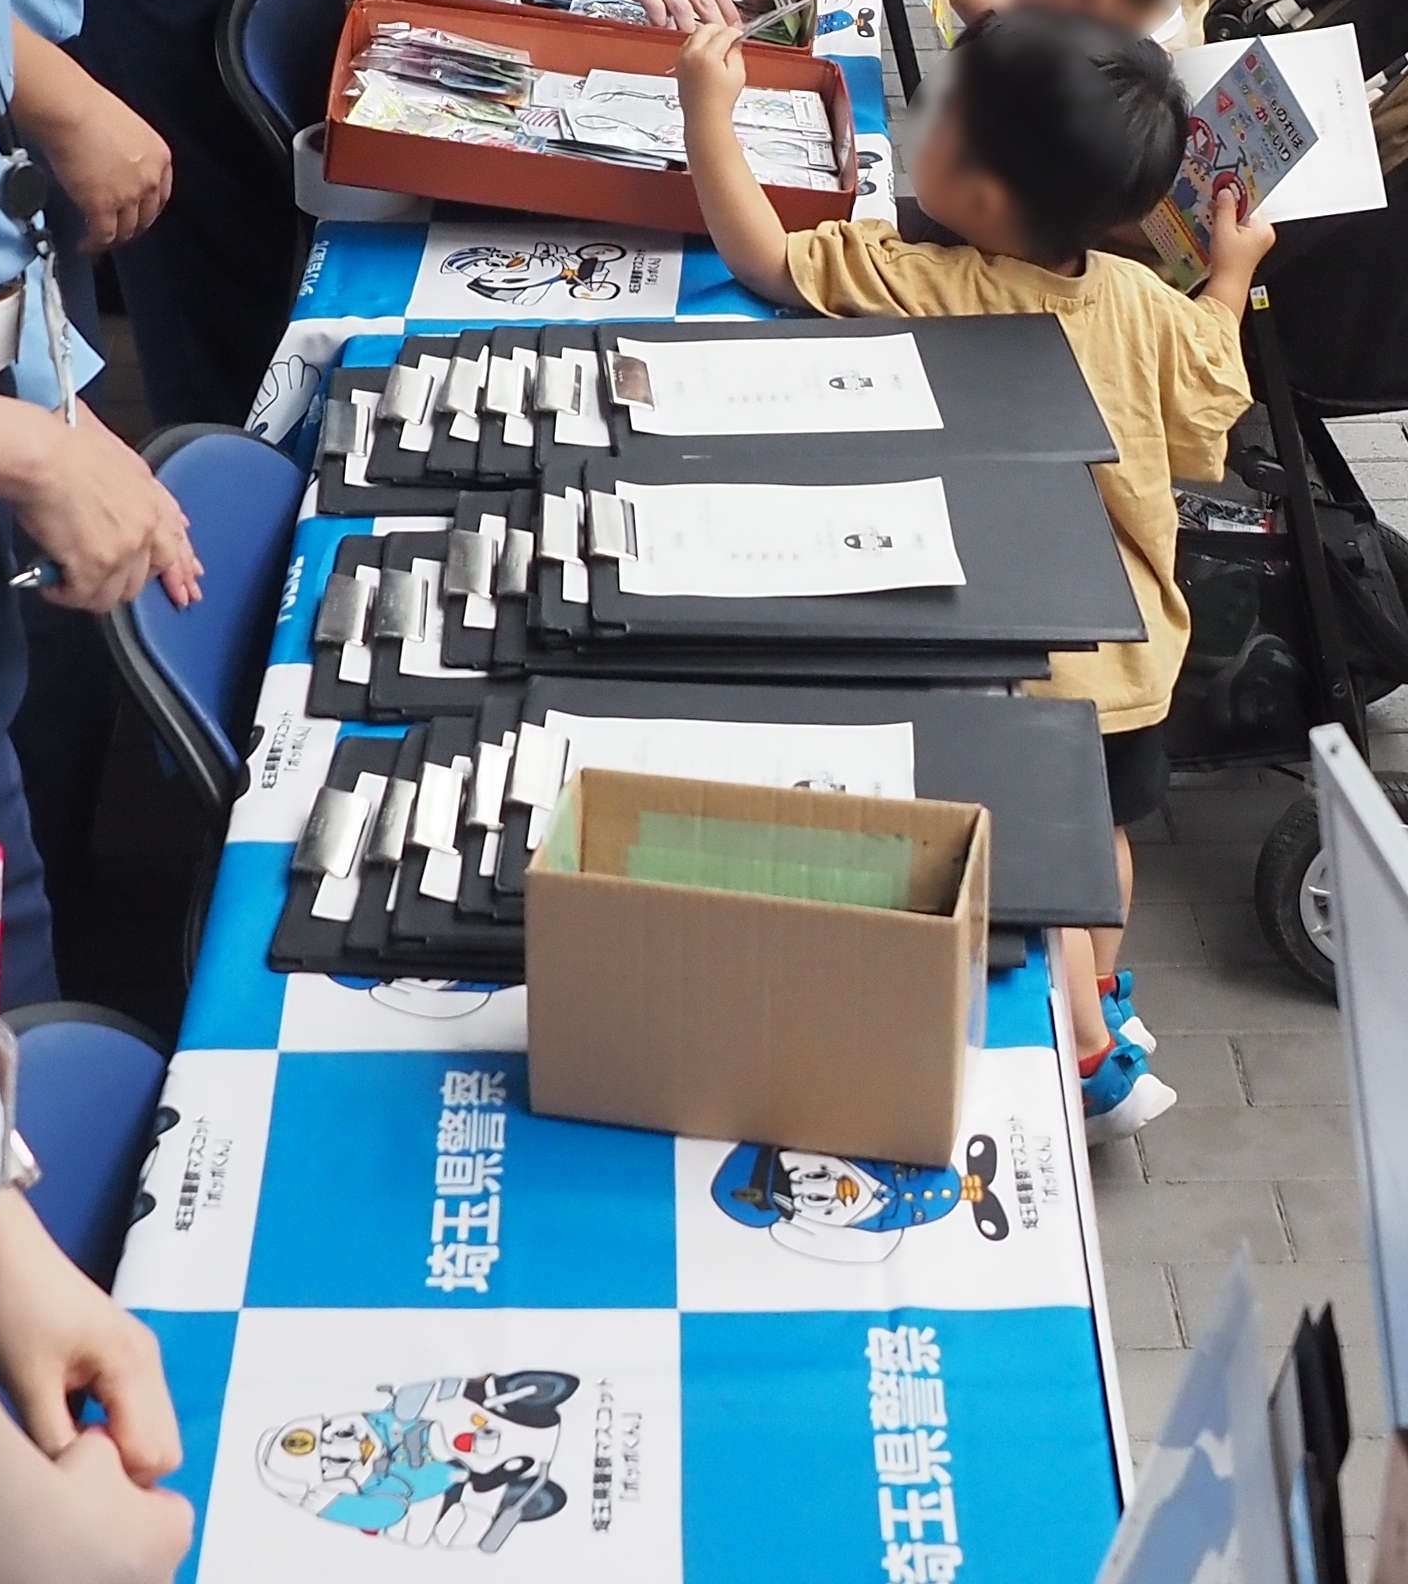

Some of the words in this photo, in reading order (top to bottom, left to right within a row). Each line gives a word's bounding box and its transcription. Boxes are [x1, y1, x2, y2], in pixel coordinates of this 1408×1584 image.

[424, 1069, 508, 1295] 埼玉県警察
[864, 1324, 963, 1584] 埼玉県警察
